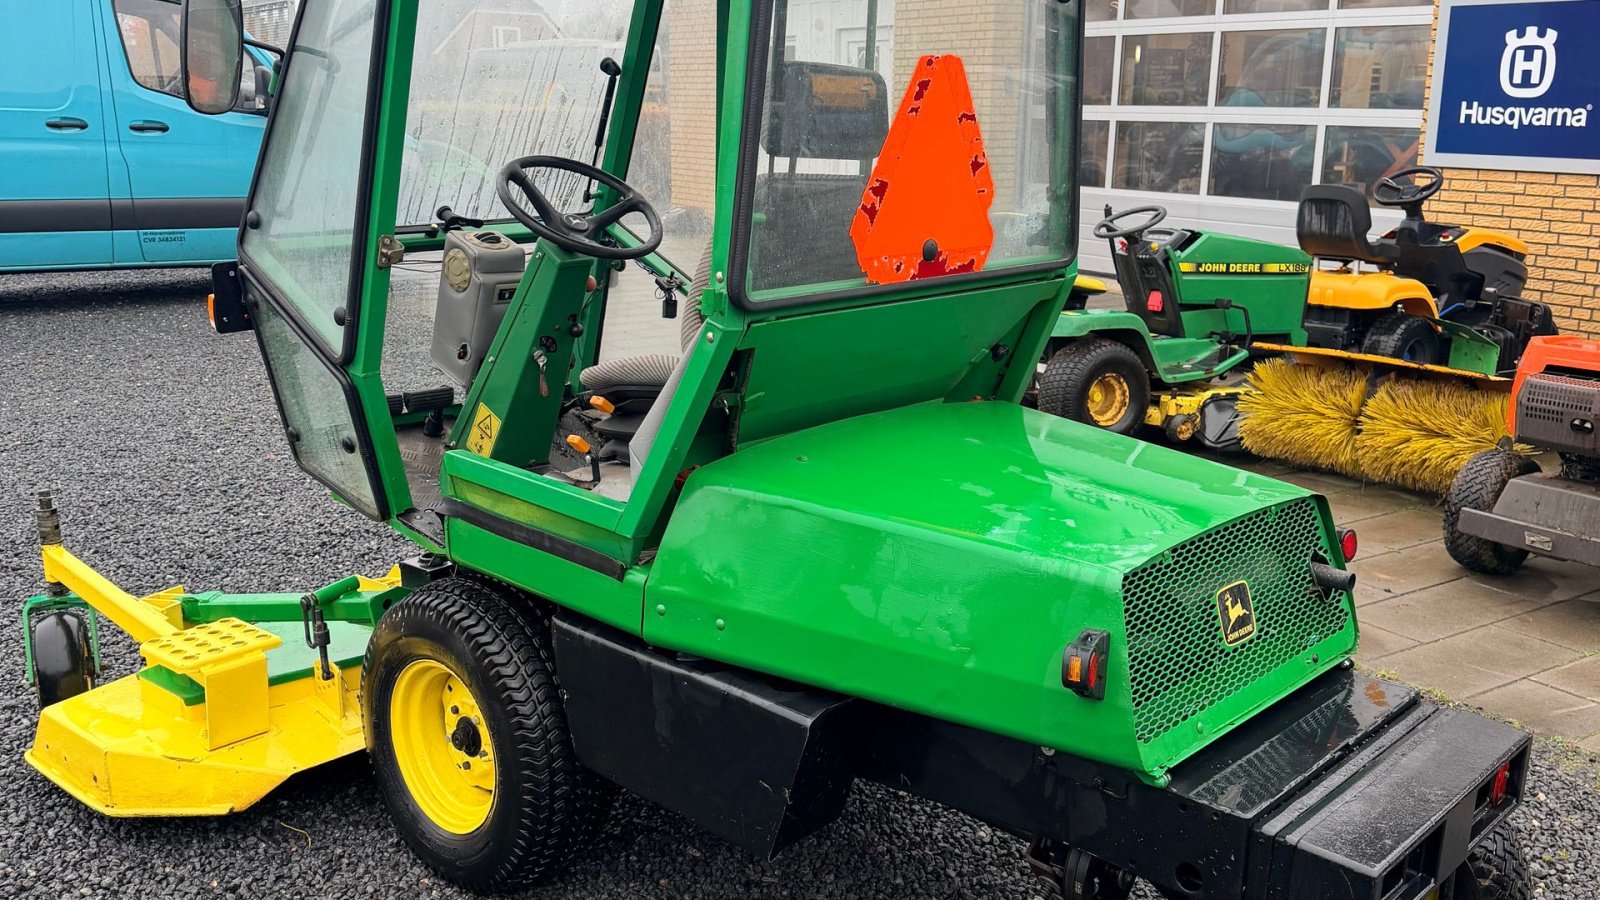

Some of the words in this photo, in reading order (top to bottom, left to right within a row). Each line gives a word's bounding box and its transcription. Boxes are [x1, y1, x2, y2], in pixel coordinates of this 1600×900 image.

[1198, 263, 1227, 272] JOHN
[1229, 263, 1261, 272] DEERE
[1227, 630, 1240, 642] JOHN
[1238, 624, 1254, 637] DEERE
